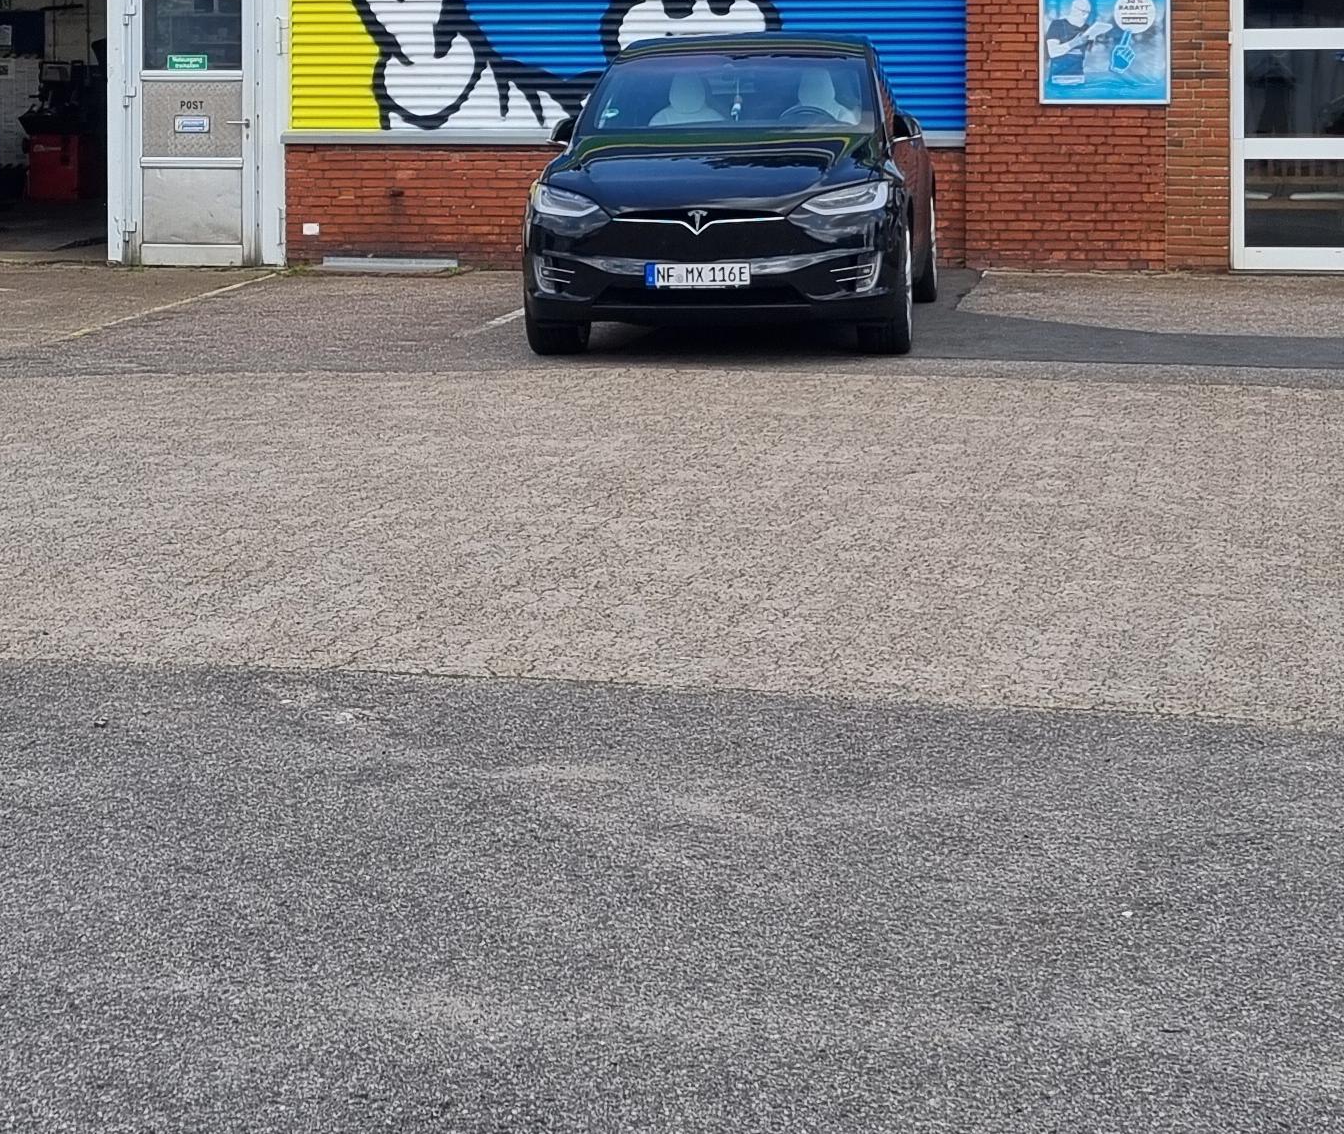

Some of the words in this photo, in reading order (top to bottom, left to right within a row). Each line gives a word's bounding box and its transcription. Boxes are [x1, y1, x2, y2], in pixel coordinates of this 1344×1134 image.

[180, 100, 204, 110] POST
[656, 266, 675, 283] NF
[685, 266, 704, 283] MX
[708, 266, 748, 283] 116E
